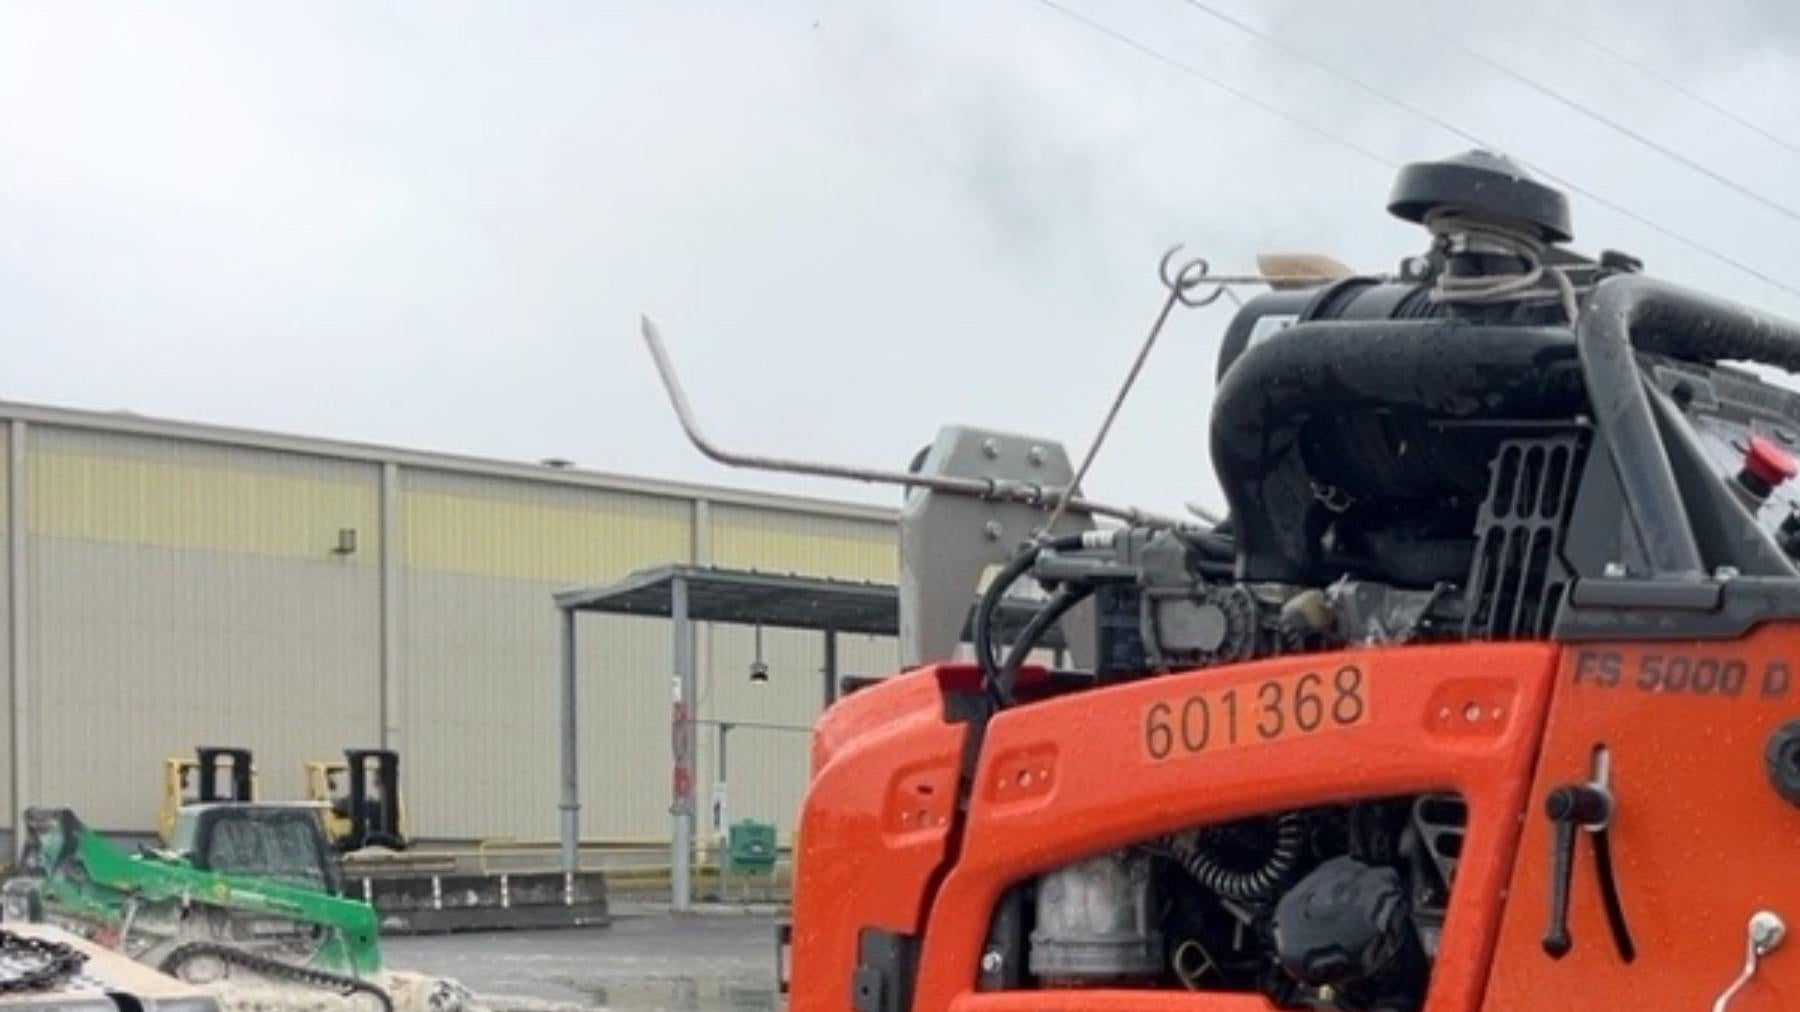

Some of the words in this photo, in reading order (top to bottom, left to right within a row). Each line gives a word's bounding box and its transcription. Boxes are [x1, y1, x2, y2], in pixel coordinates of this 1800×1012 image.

[1573, 651, 1622, 688] FS
[1636, 654, 1747, 696] 5000
[1761, 660, 1790, 699] D
[1145, 664, 1364, 760] 601368
